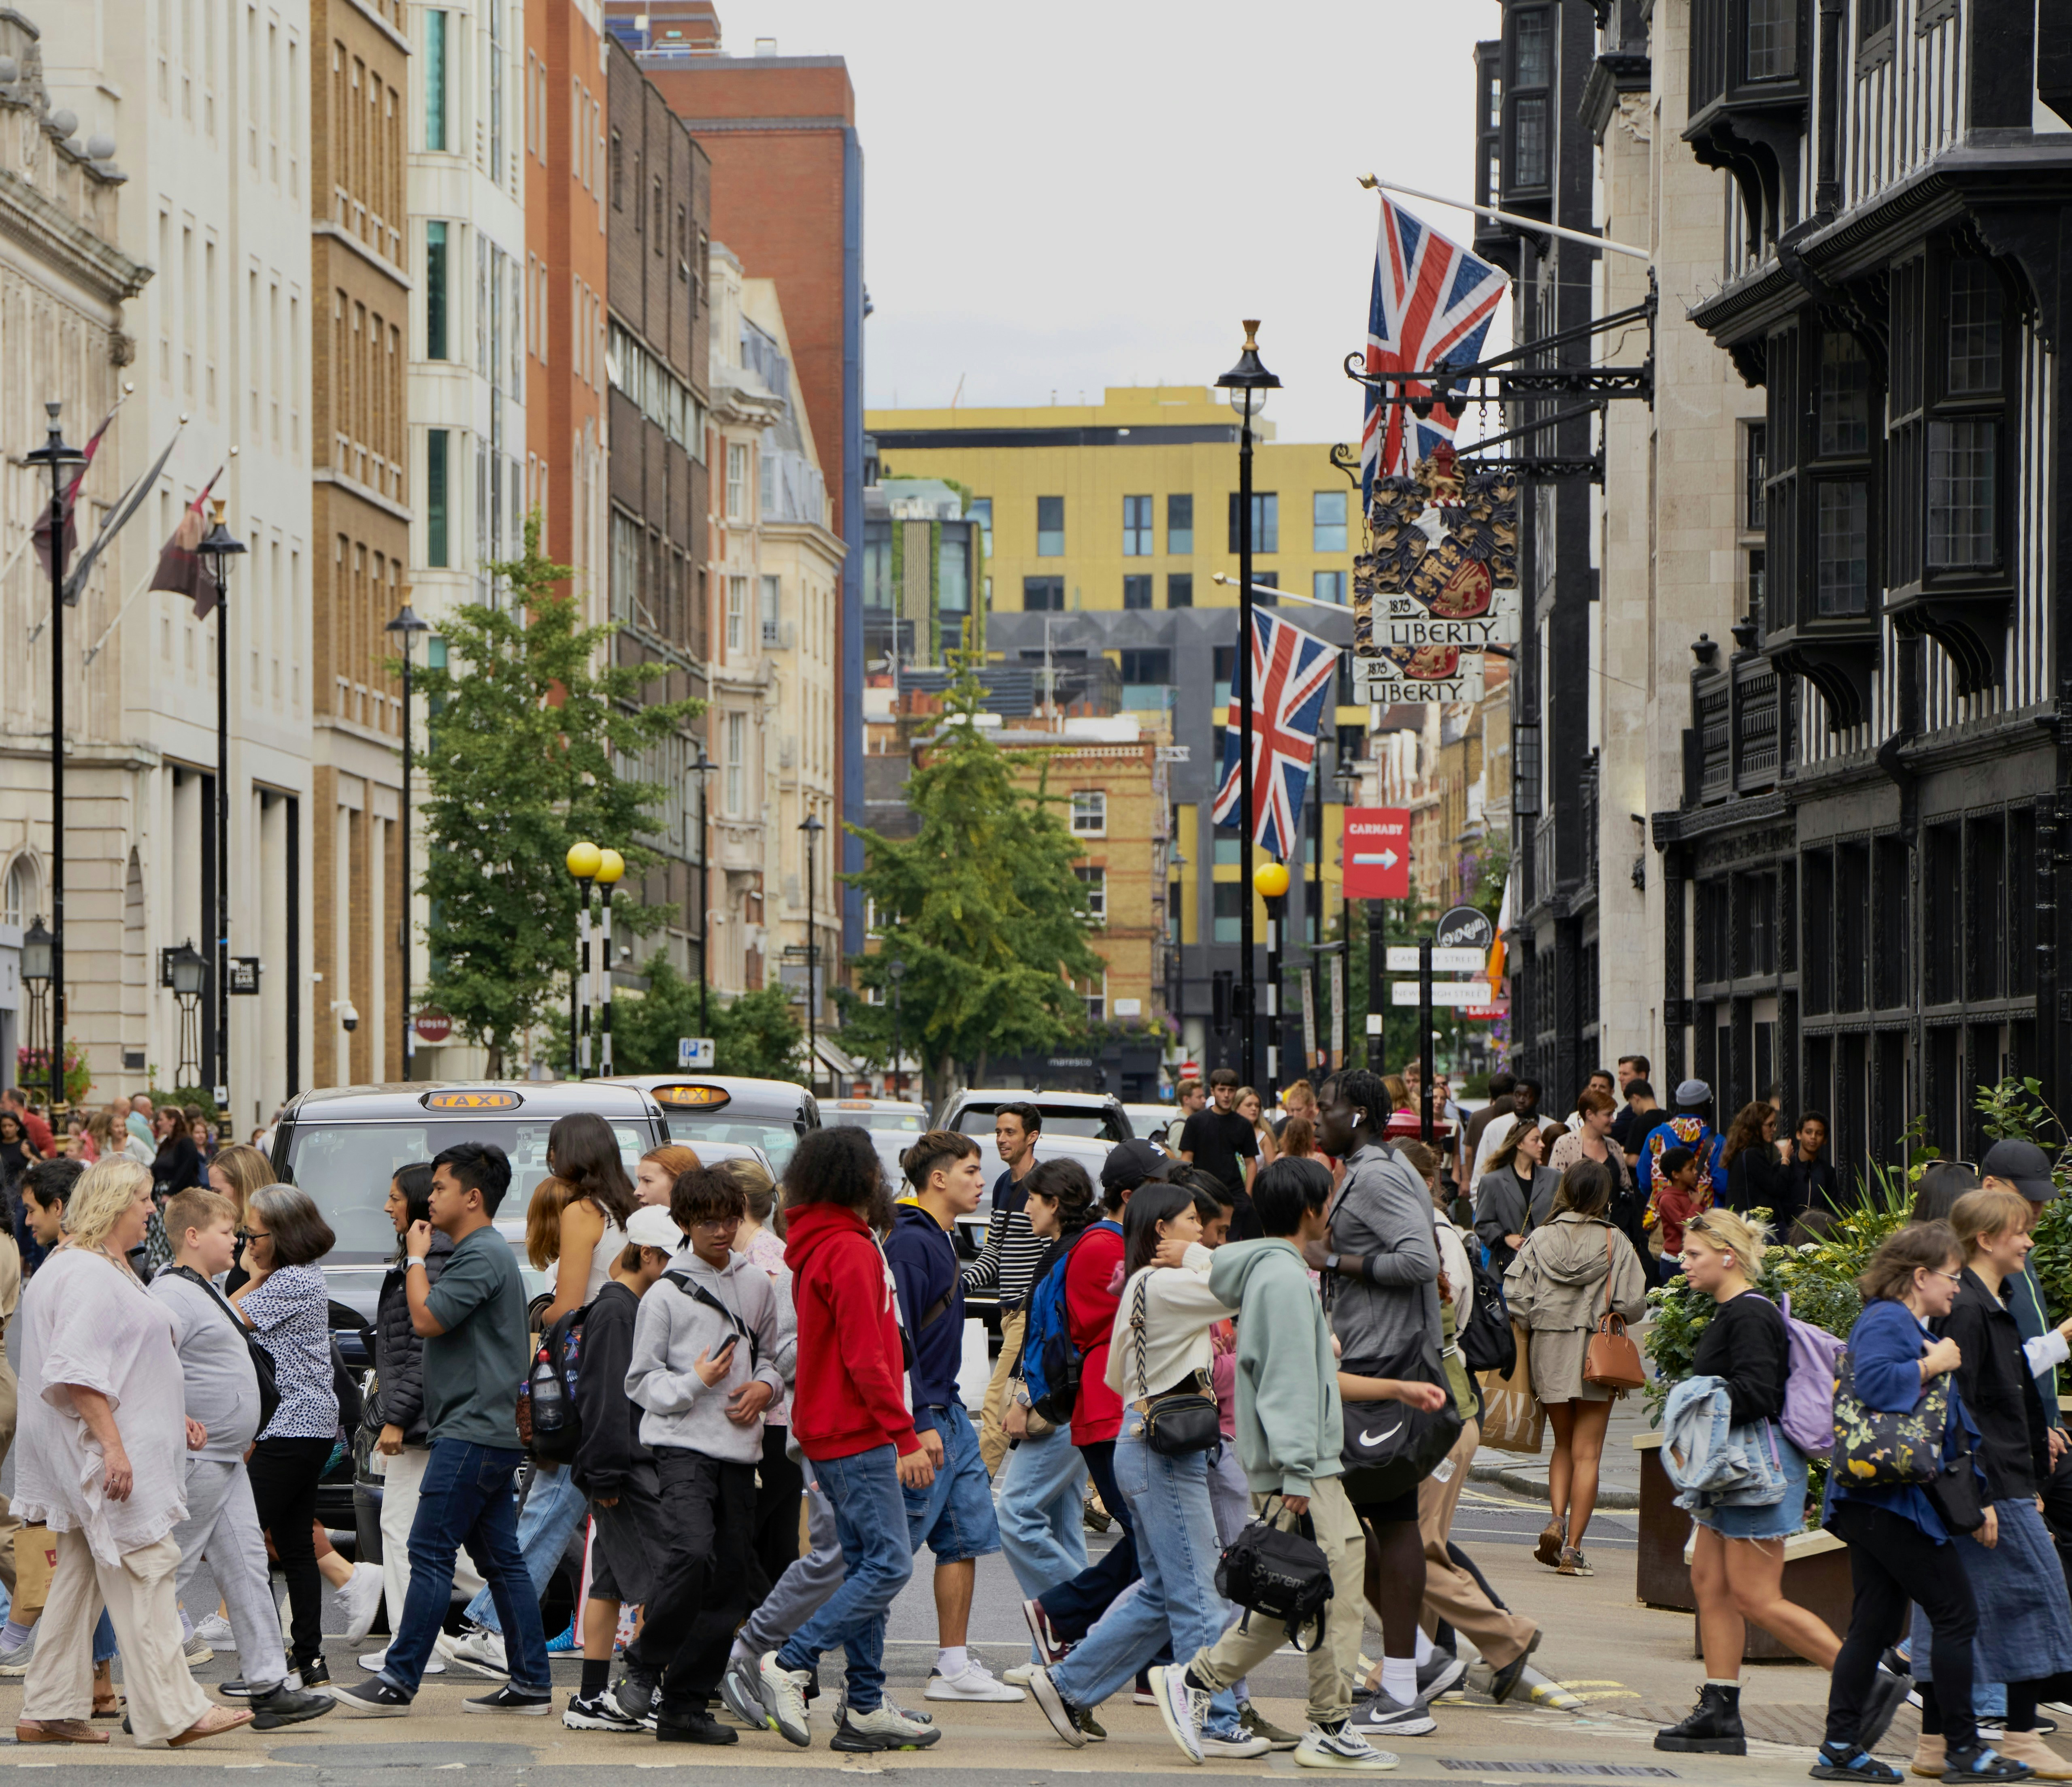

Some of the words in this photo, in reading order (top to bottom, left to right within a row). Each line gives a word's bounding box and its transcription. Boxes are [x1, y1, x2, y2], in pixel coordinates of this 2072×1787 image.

[1389, 599, 1410, 613] 1875
[1368, 662, 1387, 674] 1875
[1349, 823, 1403, 835] CARNABY
[439, 1096, 504, 1106] TAXI
[667, 1089, 712, 1101] TAXI
[1251, 1563, 1312, 1588] Sprem
[1258, 1600, 1282, 1613] Supreme
